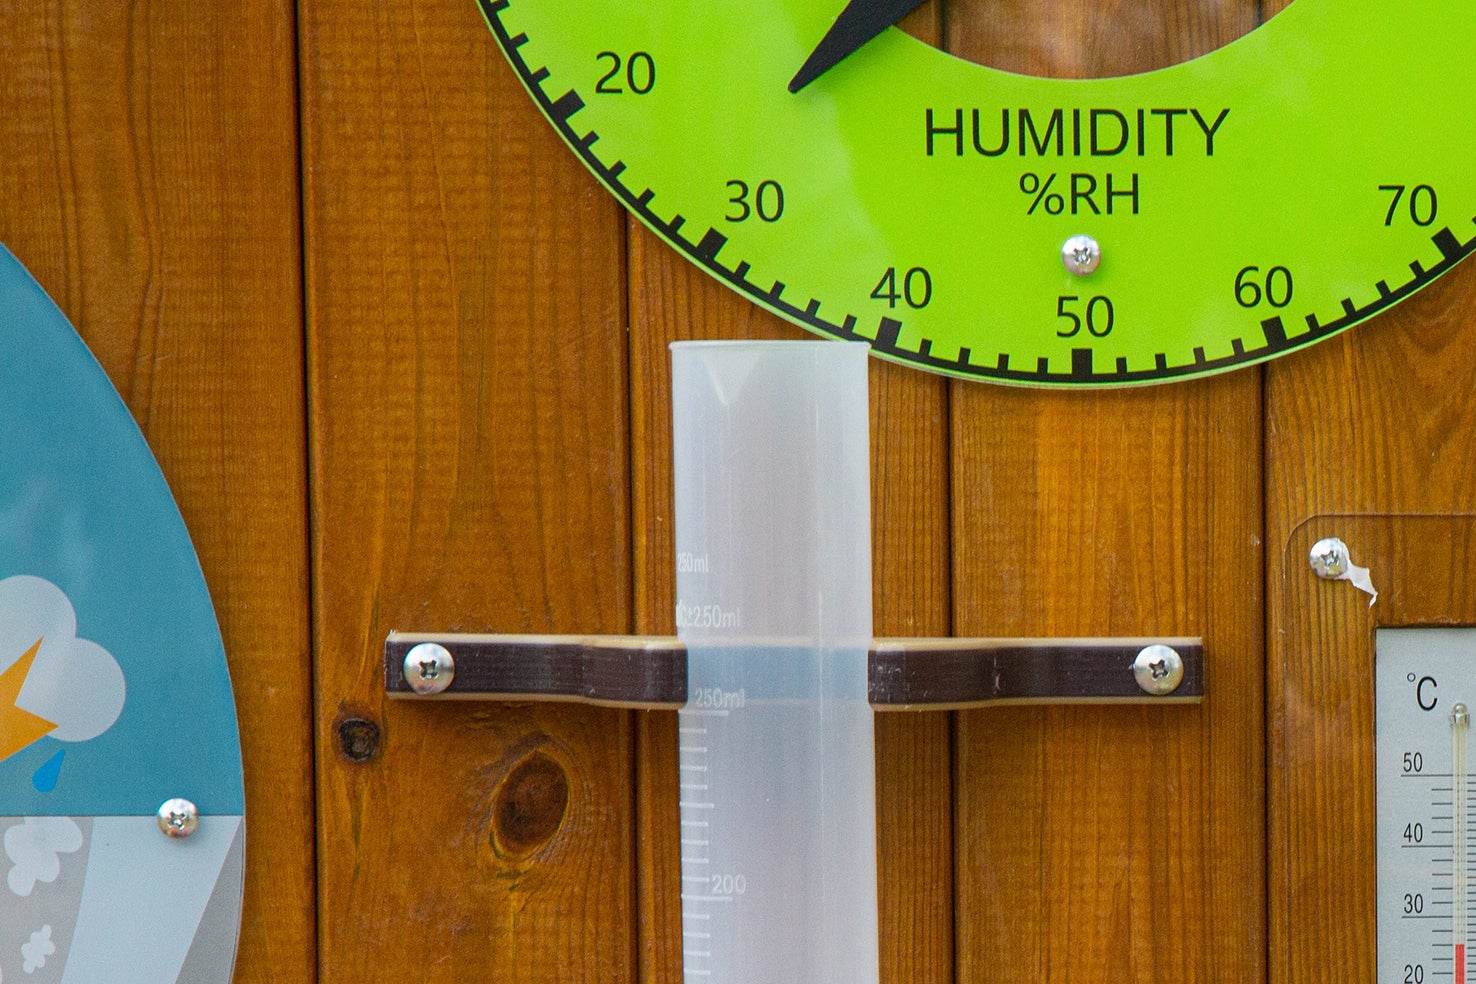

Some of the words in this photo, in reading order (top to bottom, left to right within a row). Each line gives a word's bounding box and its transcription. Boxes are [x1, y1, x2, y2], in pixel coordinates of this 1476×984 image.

[595, 51, 656, 95] 20
[925, 108, 1230, 157] HUMIDITY
[724, 180, 785, 223] 30
[1019, 172, 1139, 216] %RH
[1377, 184, 1438, 227] 70
[870, 266, 932, 309] 40
[1234, 265, 1294, 308] 60
[1056, 295, 1115, 338] 50
[1403, 751, 1423, 773] 50
[1403, 822, 1423, 843] 40
[711, 875, 746, 895] 200
[1403, 893, 1424, 914] 30
[1403, 964, 1424, 984] 20
